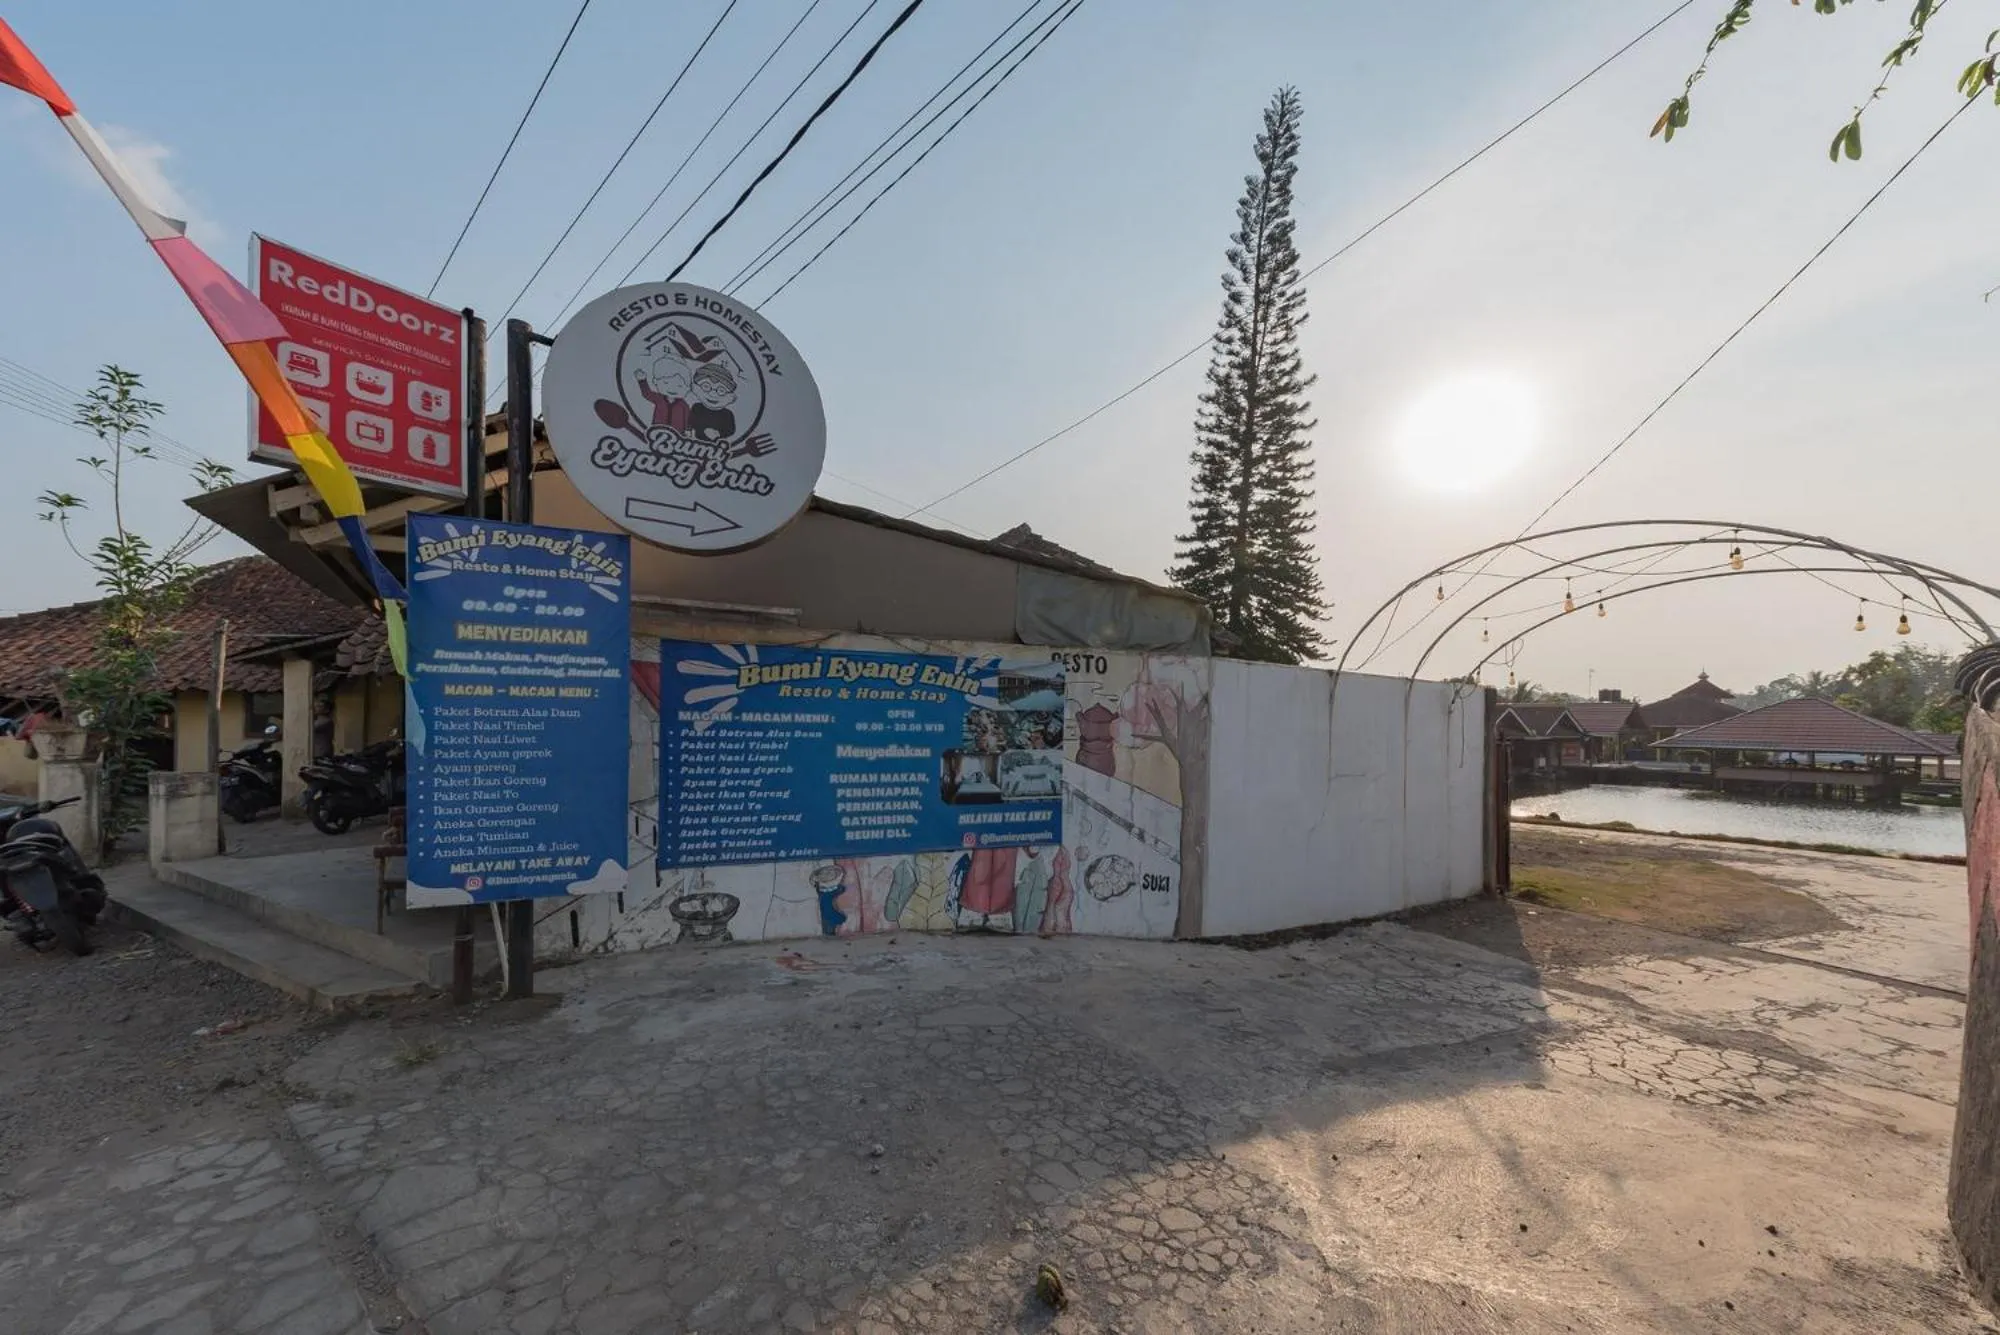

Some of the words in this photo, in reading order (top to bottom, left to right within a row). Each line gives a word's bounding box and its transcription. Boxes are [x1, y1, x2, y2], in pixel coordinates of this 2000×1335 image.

[269, 258, 456, 344] RedDoorz
[609, 292, 668, 332] RESTO
[674, 293, 688, 305] &
[695, 295, 784, 376] HOMESTAY
[646, 424, 732, 462] Bumi
[591, 435, 700, 489] Eyang
[698, 459, 775, 496] Enin
[418, 530, 486, 563] Bumi
[492, 530, 571, 555] Eyang
[570, 544, 621, 577] Enin
[453, 560, 499, 573] Resto
[501, 564, 512, 574] &
[516, 565, 557, 578] Home
[559, 568, 593, 582] Stay
[503, 585, 547, 599] Open
[457, 624, 588, 644] MENYEDIAKAN
[433, 648, 483, 660] Rumah
[534, 653, 608, 666] Penginapan,
[415, 663, 499, 675] Pernikahan,
[738, 656, 822, 688] Bumi
[827, 656, 919, 685] Eyang
[919, 664, 981, 696] Enin
[444, 684, 493, 696] MACAM
[509, 685, 556, 697] MACAM
[559, 687, 592, 697] MENU
[779, 685, 832, 697] Resto
[838, 687, 851, 699] &
[856, 687, 905, 700] Home
[910, 689, 946, 703] Stay
[433, 707, 470, 717] Paket
[473, 707, 519, 717] Botram
[521, 708, 549, 717] Alas
[550, 708, 581, 717] Daun
[678, 711, 732, 721] MACAM
[742, 712, 792, 722] MACAM
[794, 713, 830, 723] MENU
[888, 710, 915, 719] OPEN
[433, 721, 470, 730] Paket
[473, 721, 501, 730] Nasi
[503, 721, 544, 730] Timbel
[924, 723, 944, 732] WIB
[433, 735, 470, 744] Paket
[473, 735, 501, 744] Nasi
[504, 735, 537, 744] Liwet
[433, 749, 470, 758] Paket
[472, 750, 509, 760] Ayam
[836, 744, 931, 760] Menyediakan
[433, 764, 471, 774] Ayam
[473, 764, 516, 774] goreng
[680, 766, 716, 774] Paket
[719, 766, 751, 775] Ayam
[433, 777, 470, 787] Paket
[473, 777, 501, 786] Ikan
[504, 776, 547, 786] Goreng
[683, 780, 717, 788] Ayam
[719, 779, 763, 787] goreng
[829, 773, 878, 784] RUMAH
[880, 773, 929, 784] MAKAN,
[433, 792, 470, 801] Paket
[473, 791, 501, 800] Nasi
[503, 790, 519, 799] To
[680, 791, 716, 799] Paket
[718, 790, 745, 798] Ikan
[836, 786, 923, 798] PENGINAPAN,
[433, 806, 462, 815] Ikan
[465, 805, 514, 814] Gurame
[517, 803, 559, 813] Goreng
[680, 803, 715, 812] Paket
[718, 802, 744, 811] Nasi
[748, 802, 762, 810] To
[836, 800, 922, 812] PERNIKAHAN,
[680, 816, 708, 825] Ikan
[711, 815, 758, 823] Gurame
[841, 814, 918, 826] GATHERING,
[958, 812, 1002, 824] MELAYANI
[1004, 811, 1026, 822] TAKE
[1028, 810, 1053, 821] AWAY
[433, 820, 474, 829] Aneka
[477, 818, 536, 828] Gorengan
[433, 833, 474, 844] Aneka
[477, 832, 529, 842] Tumisan
[679, 829, 717, 837] Aneka
[845, 829, 885, 840] REUNI
[433, 848, 474, 858] Aneka
[477, 845, 534, 855] Minuman
[536, 843, 547, 852] &
[548, 842, 580, 852] Juice
[679, 841, 717, 850] Aneka
[679, 853, 717, 863] Aneka
[450, 860, 516, 874] MELAYANI
[520, 857, 552, 869] TAKE
[556, 855, 591, 866] AWAY
[1142, 873, 1170, 893] SUKI
